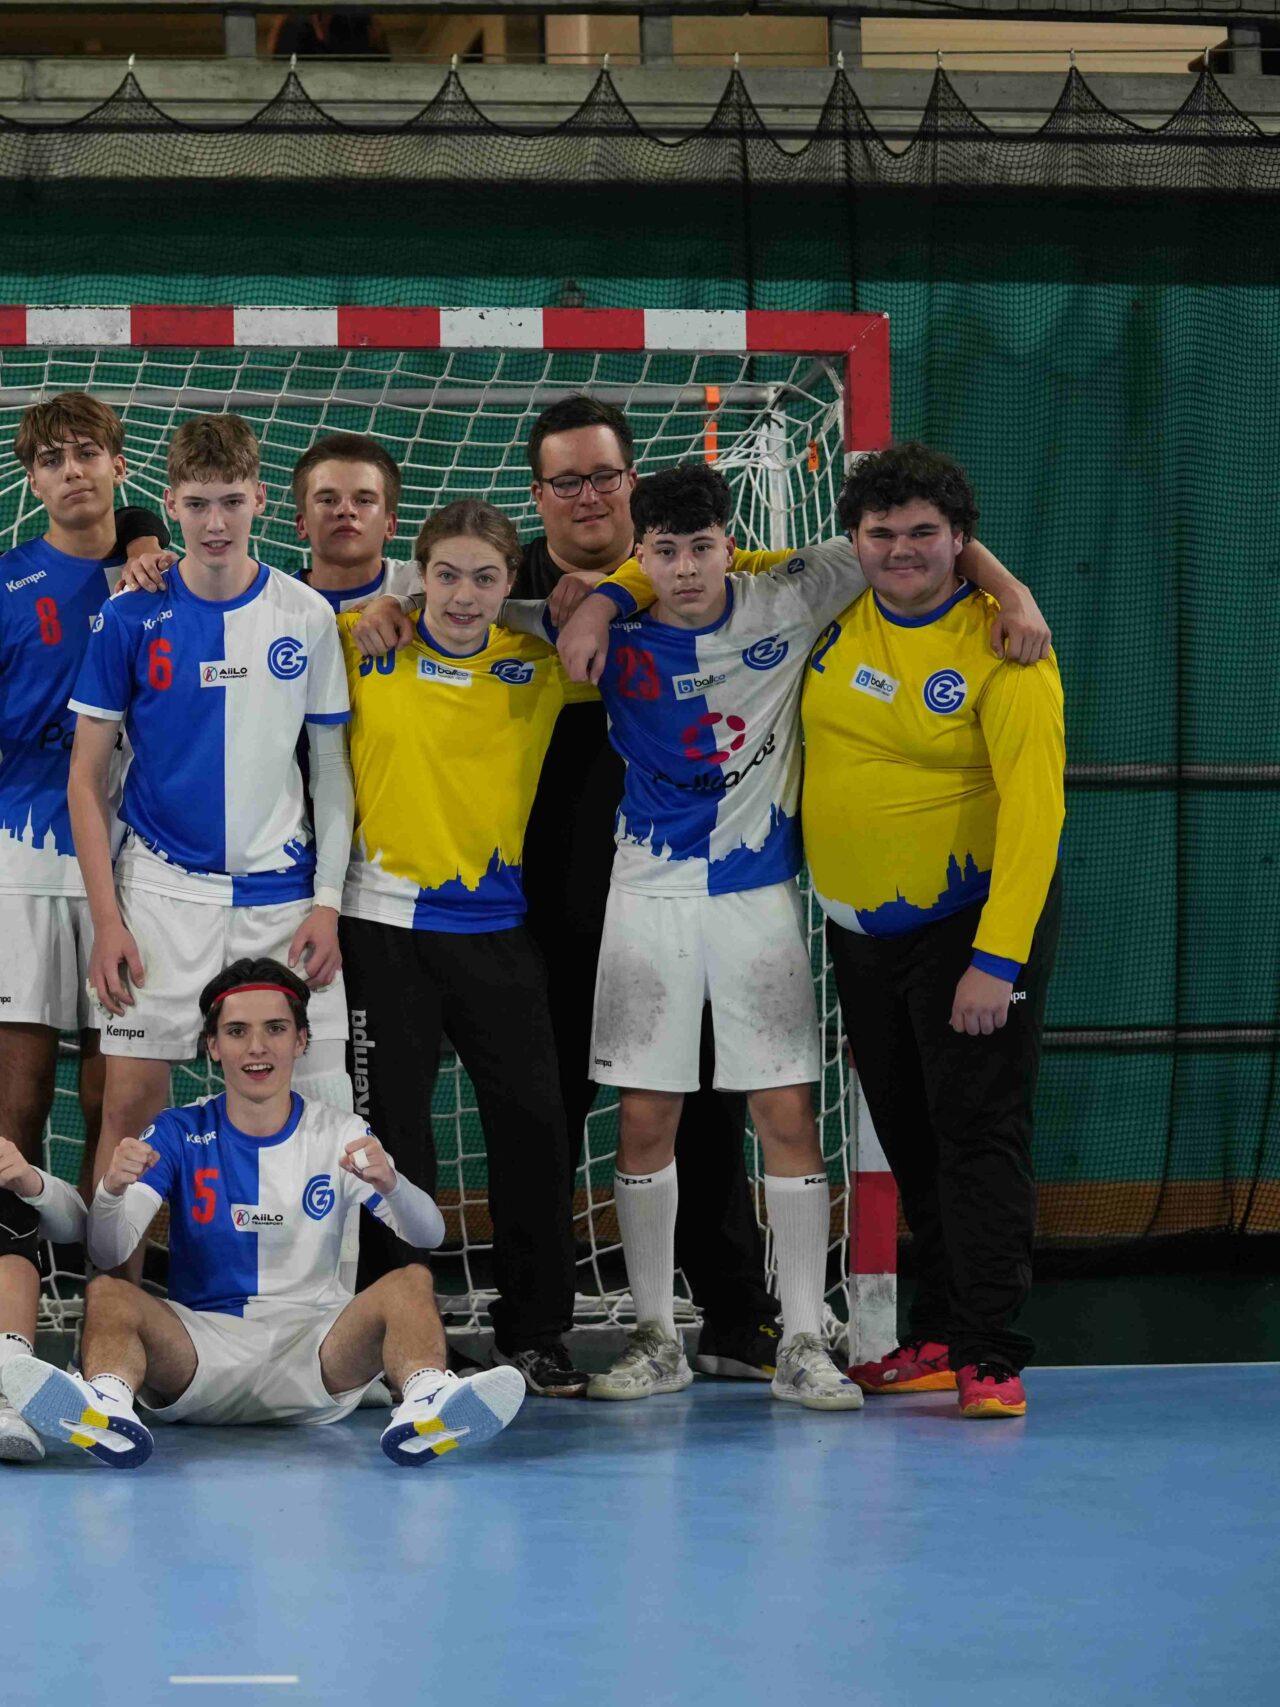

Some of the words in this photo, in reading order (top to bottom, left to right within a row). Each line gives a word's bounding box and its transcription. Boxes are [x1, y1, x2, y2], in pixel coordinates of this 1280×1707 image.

[5, 570, 47, 592] Kempa
[35, 596, 62, 645] 8
[148, 638, 173, 692] 6
[615, 646, 661, 701] 23
[693, 674, 727, 688] ballco
[106, 1025, 145, 1040] Kempa
[351, 1009, 376, 1116] Kempa
[191, 1168, 219, 1225] 5
